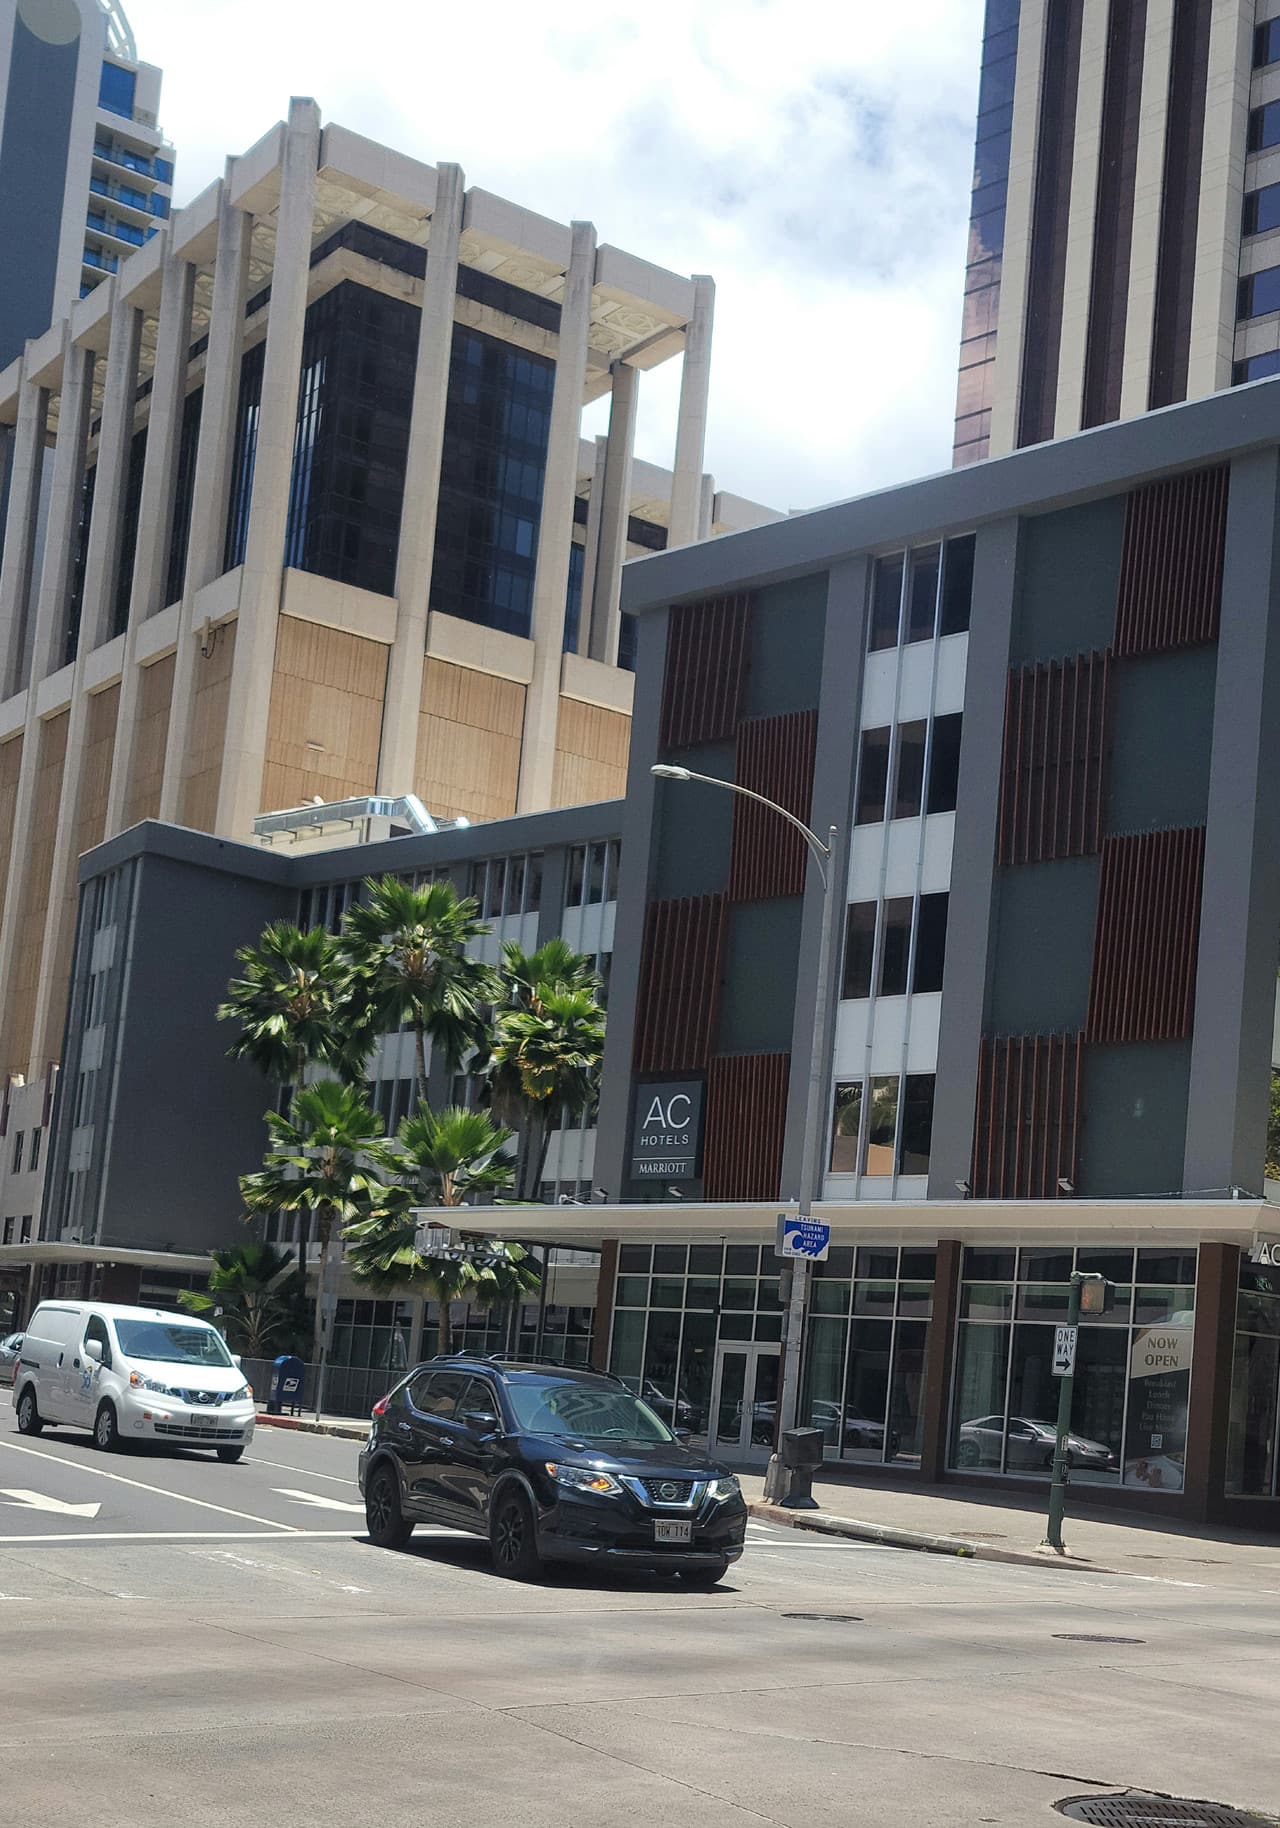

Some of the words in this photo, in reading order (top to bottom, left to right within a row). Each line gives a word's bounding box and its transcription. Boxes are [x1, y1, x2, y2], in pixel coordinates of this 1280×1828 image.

[642, 1094, 691, 1129] AC
[640, 1134, 689, 1146] HOTELS
[639, 1162, 687, 1174] MARRIOTT
[800, 1224, 824, 1233] TSUNAMI
[803, 1232, 825, 1241] HAZARD
[803, 1240, 817, 1248] AREA
[1058, 1330, 1075, 1343] ONE
[1147, 1337, 1178, 1349] NOW
[1057, 1343, 1074, 1356] WAY
[1144, 1354, 1179, 1367] OPEN
